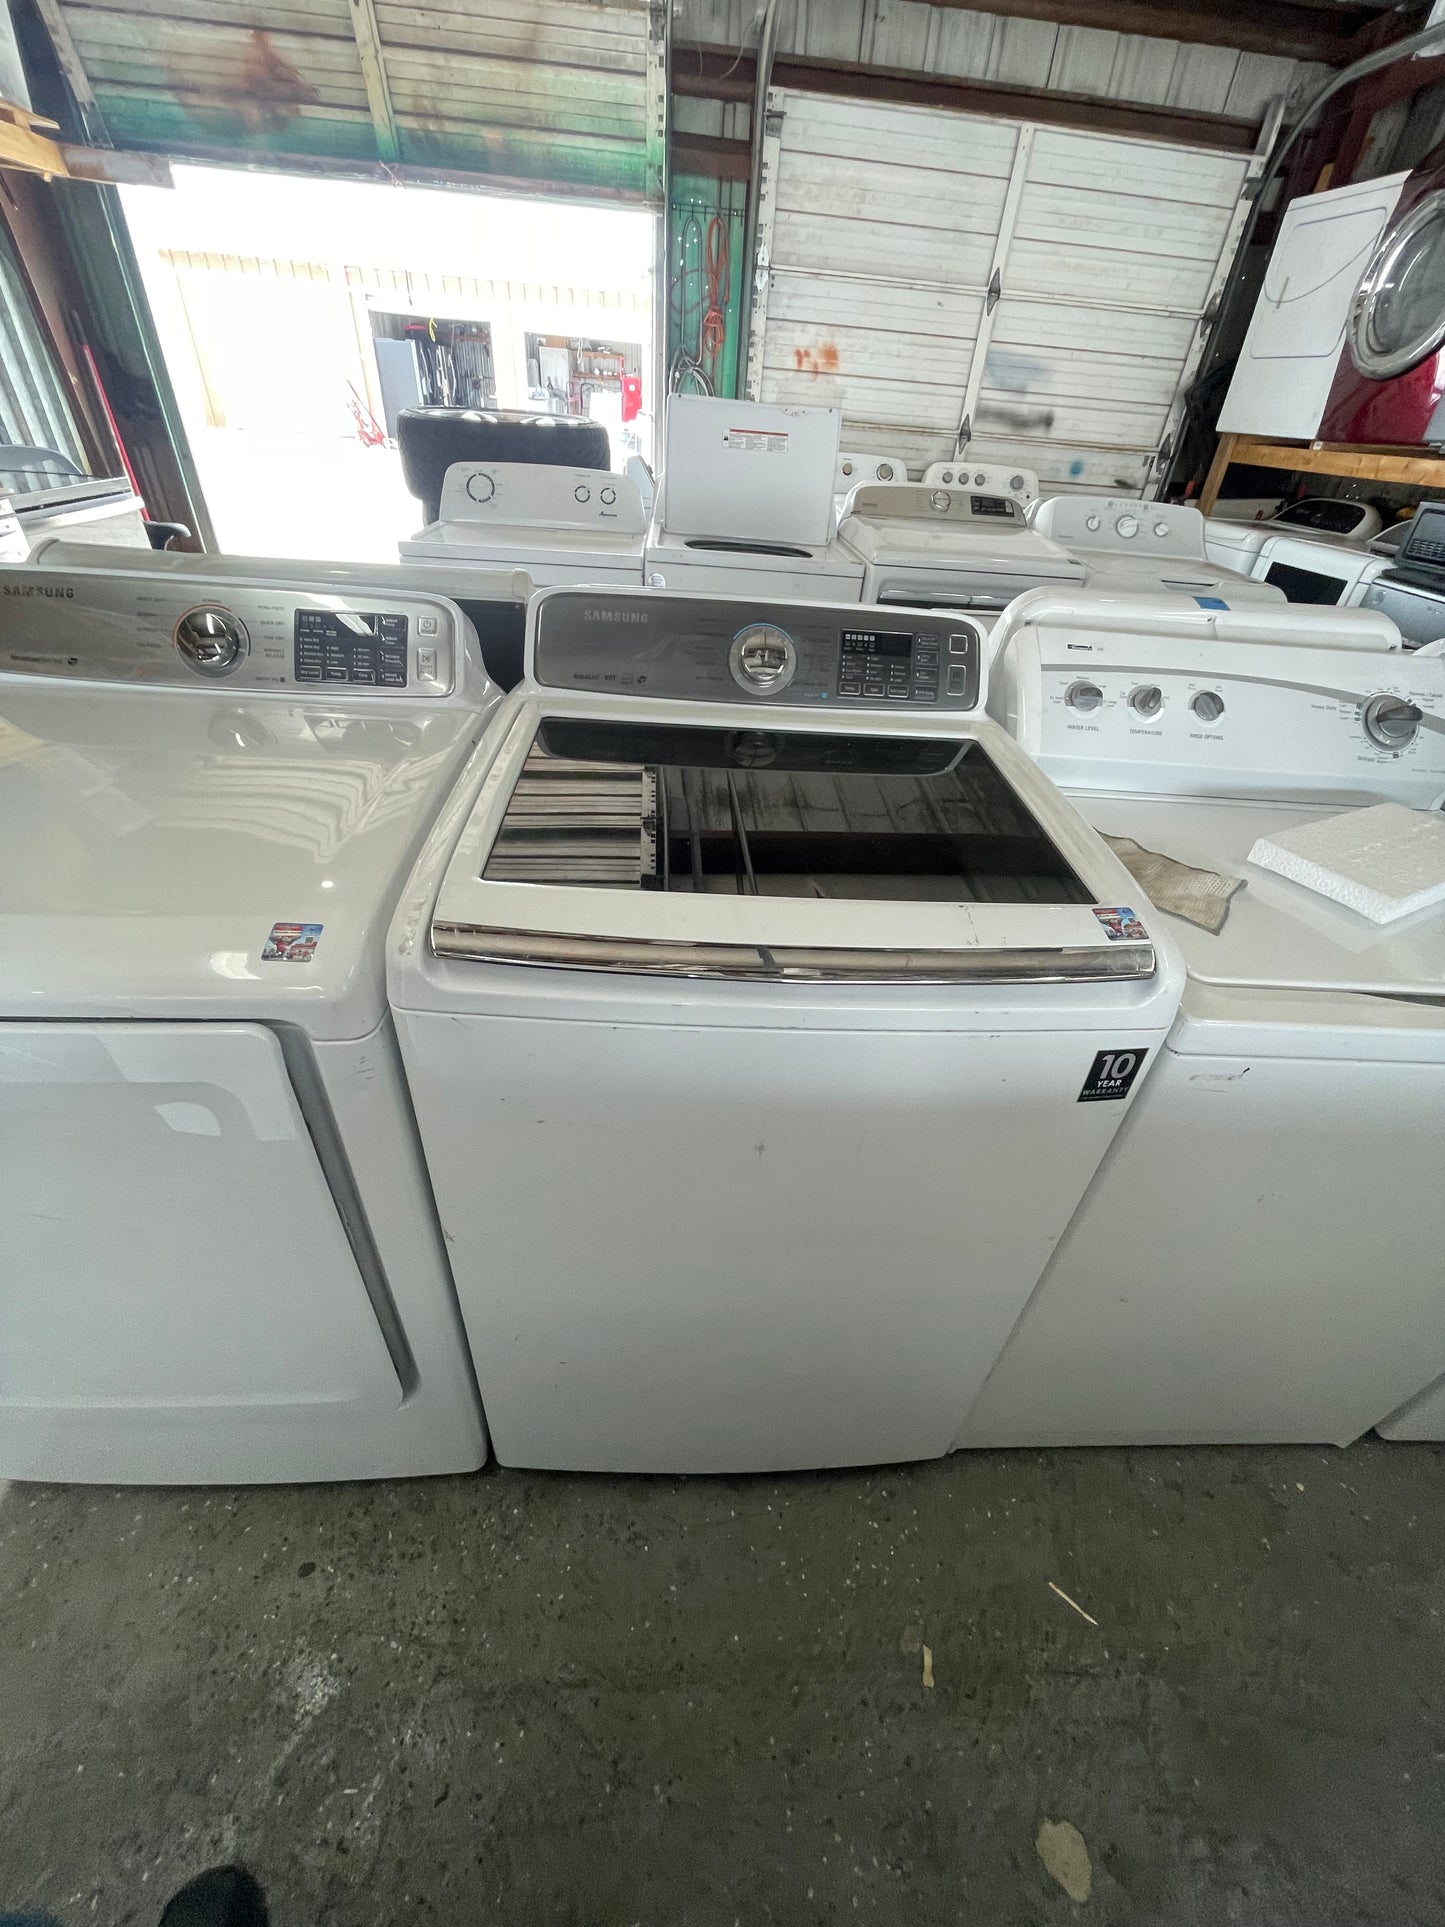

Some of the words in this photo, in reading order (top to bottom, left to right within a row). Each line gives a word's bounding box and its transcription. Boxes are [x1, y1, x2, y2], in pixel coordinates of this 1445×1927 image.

[4, 585, 75, 599] SAMSUNG
[584, 609, 648, 624] SAMSUNG
[1100, 1053, 1137, 1079] 10
[1097, 1079, 1122, 1088] YEAR
[1082, 1087, 1129, 1095] WARRANTY
